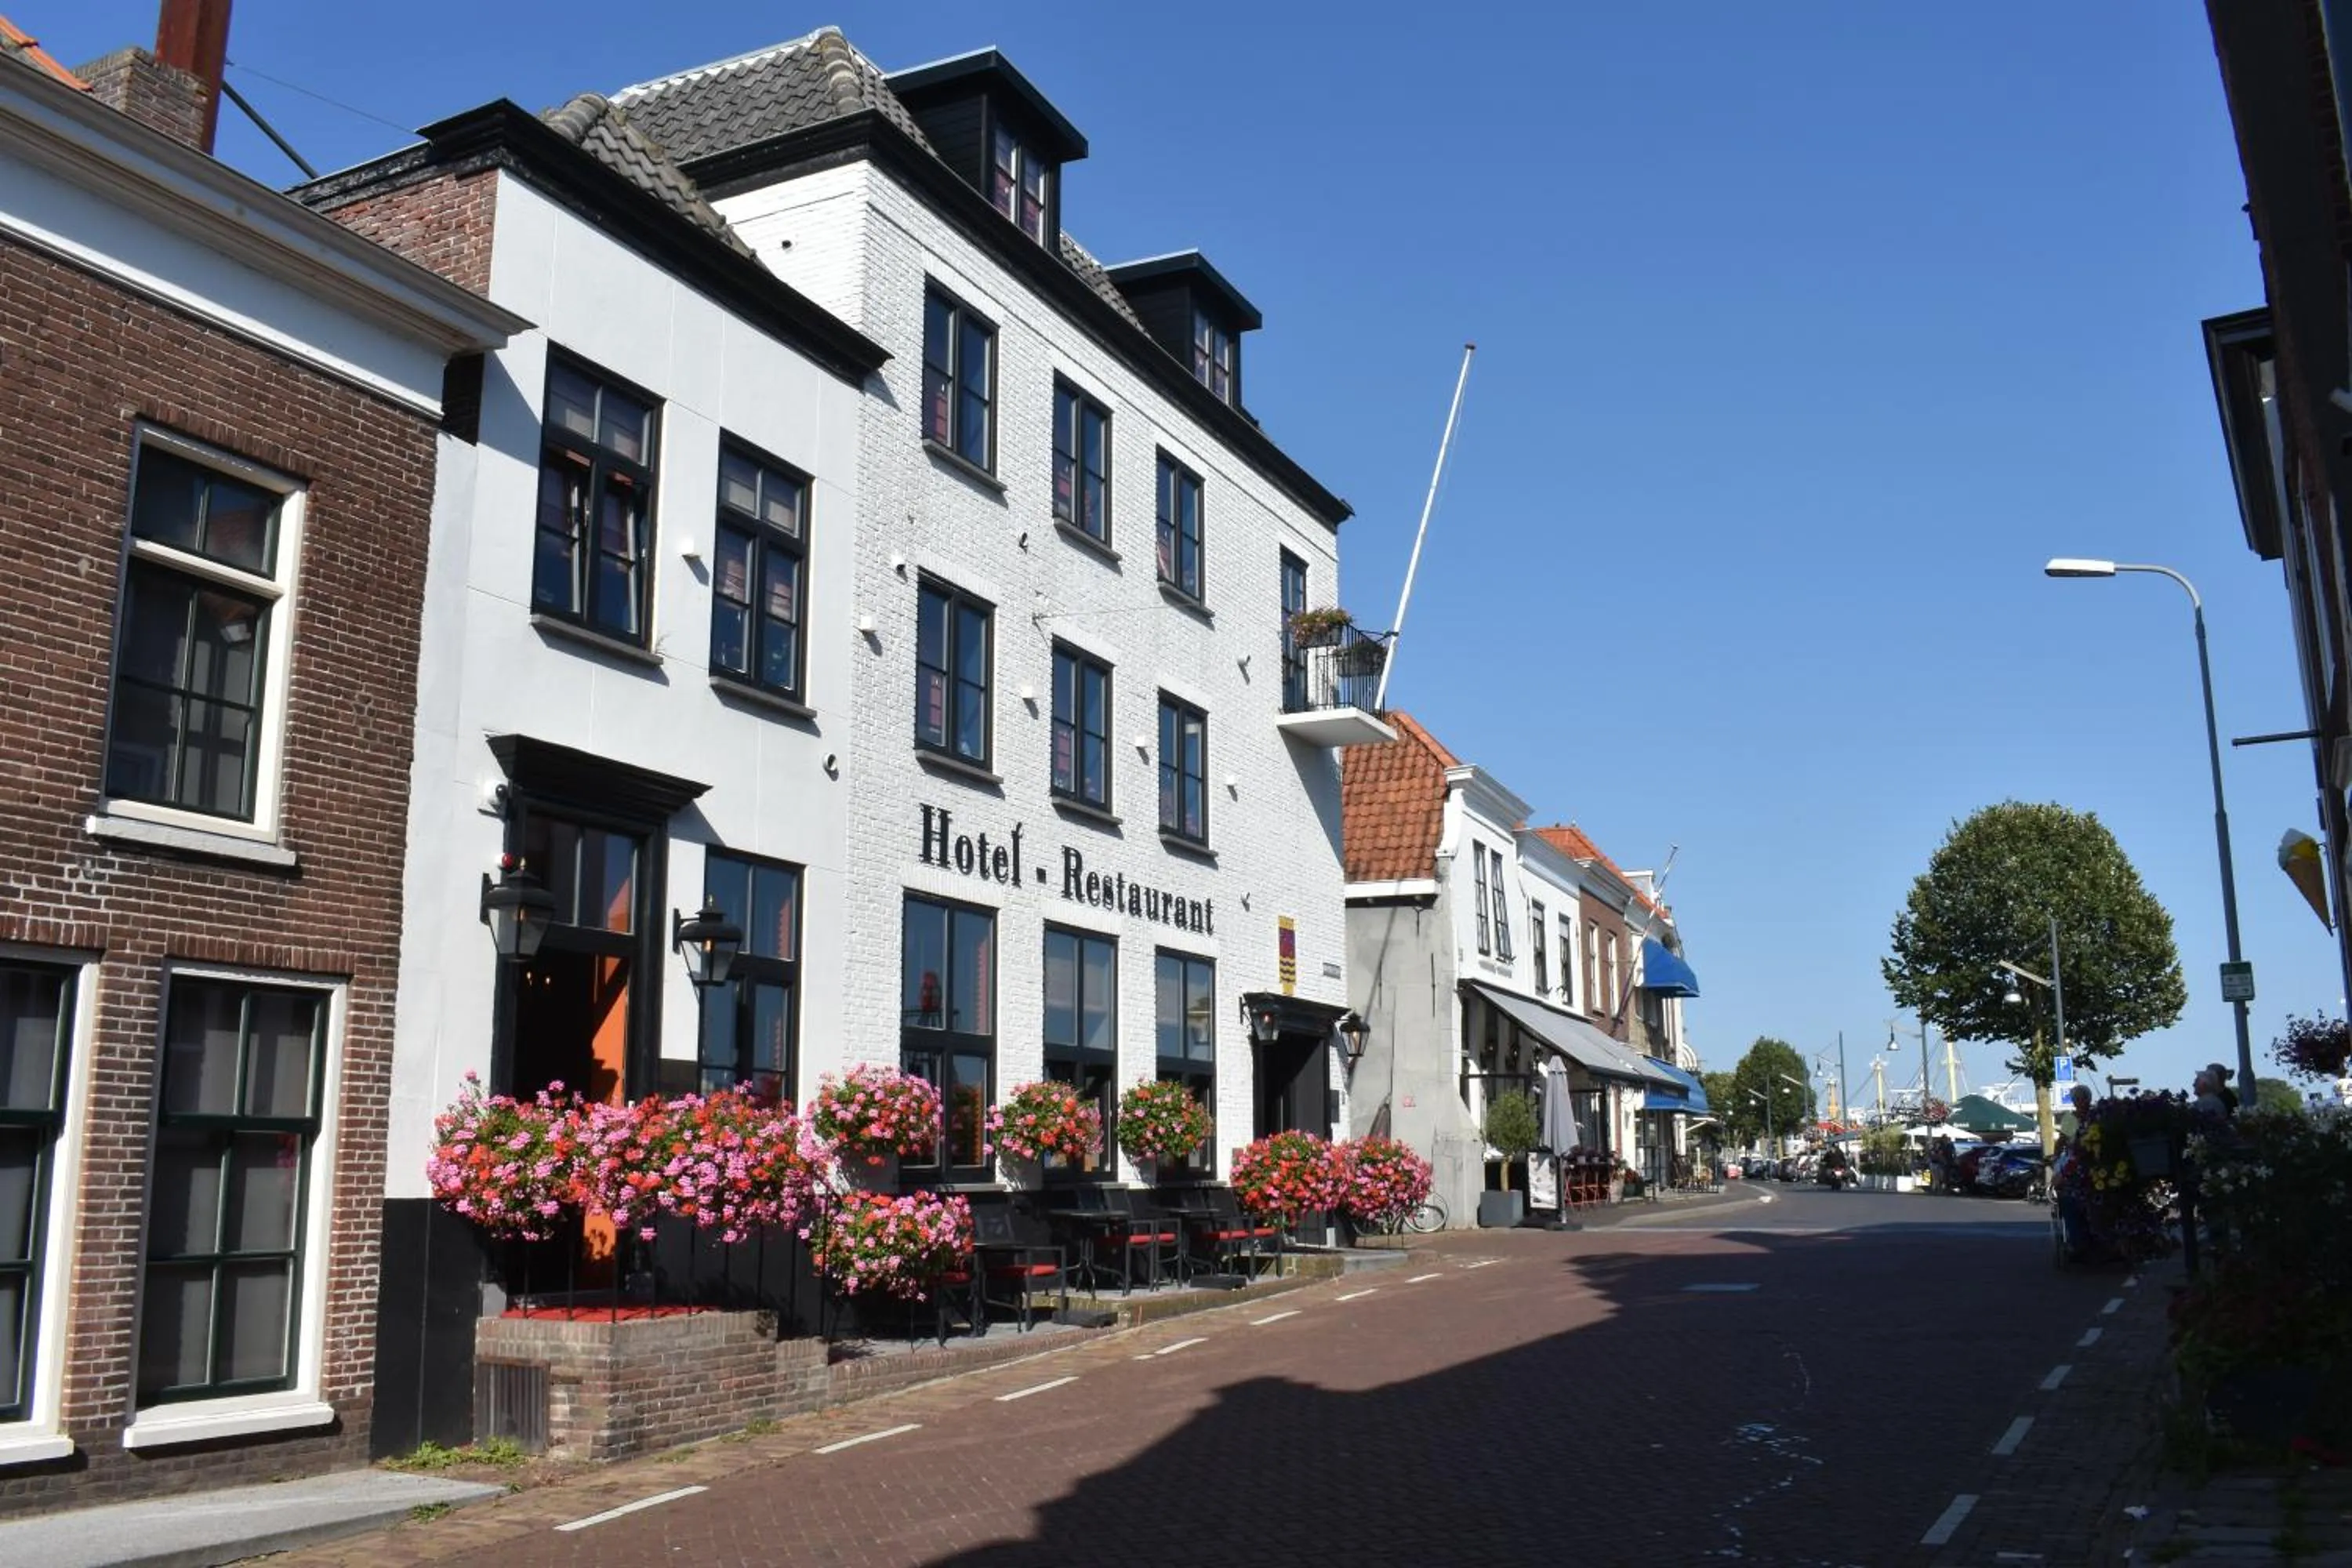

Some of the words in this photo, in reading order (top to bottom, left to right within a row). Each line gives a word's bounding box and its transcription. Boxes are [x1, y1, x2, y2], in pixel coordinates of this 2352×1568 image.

[919, 803, 1023, 887] Hotel
[1062, 844, 1214, 936] Restaurant
[2060, 1059, 2067, 1071] P
